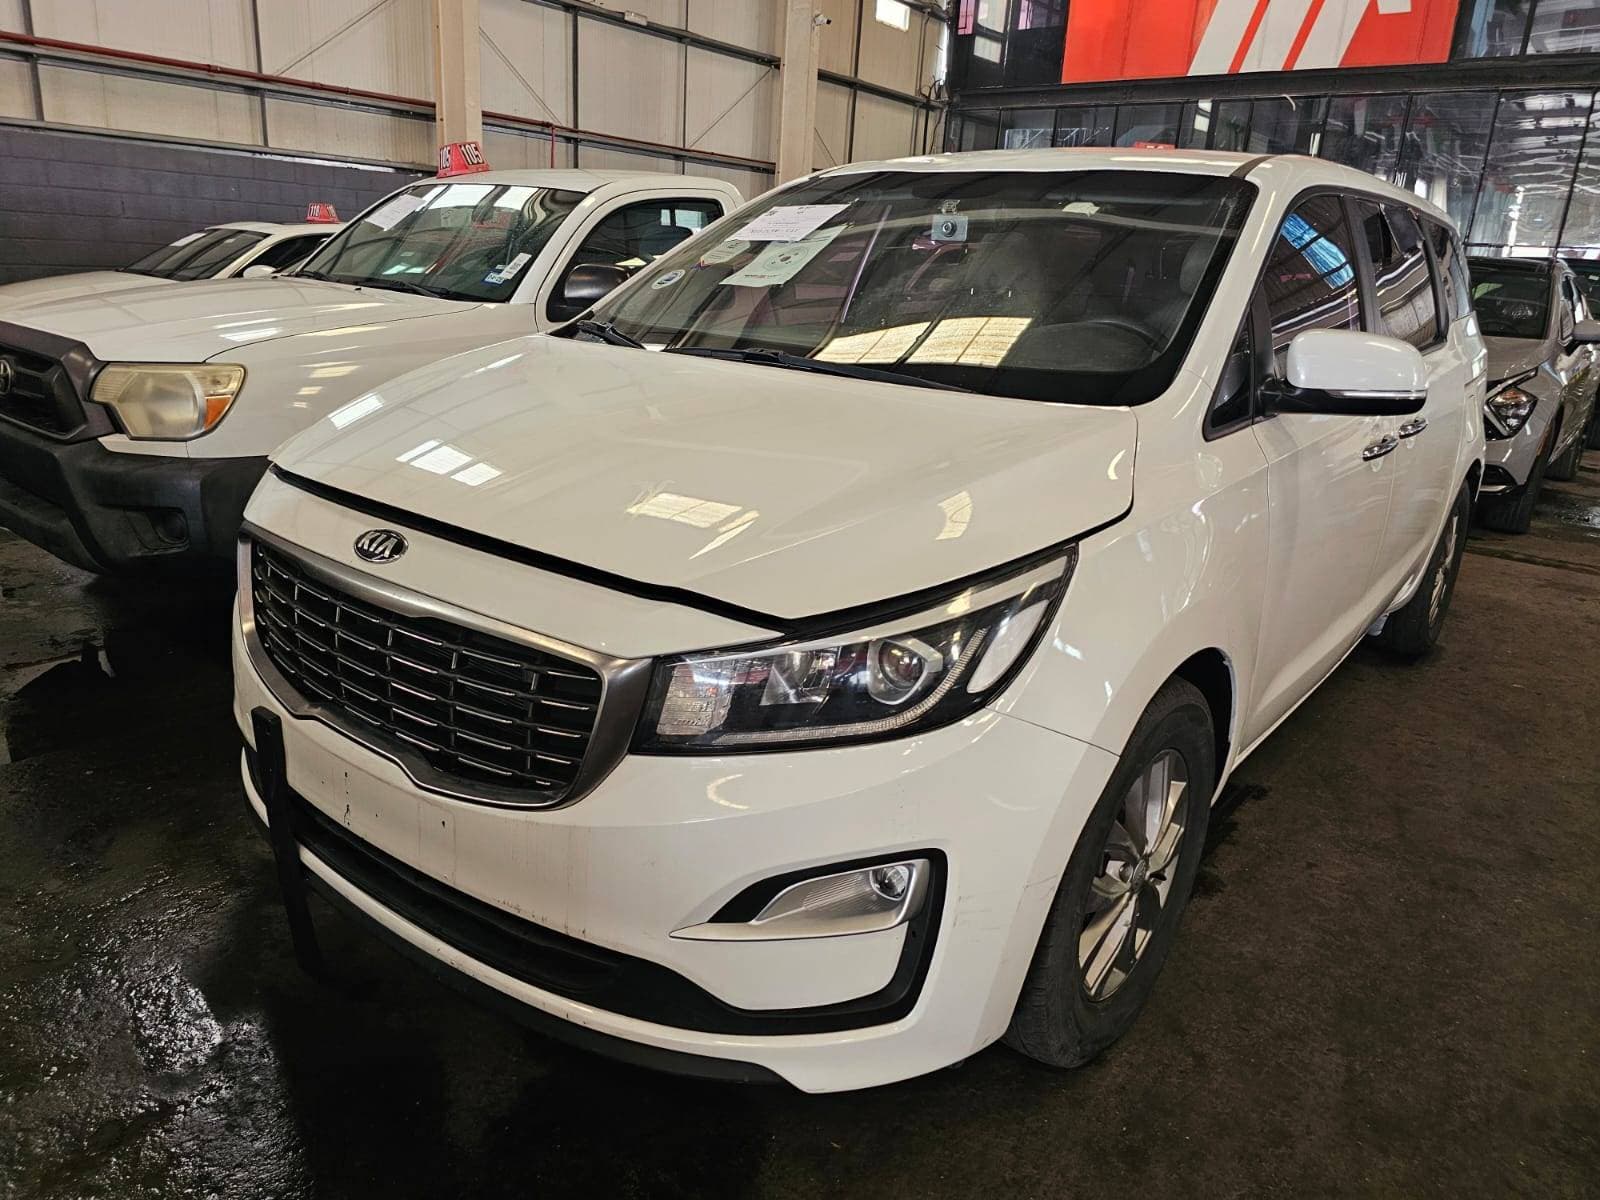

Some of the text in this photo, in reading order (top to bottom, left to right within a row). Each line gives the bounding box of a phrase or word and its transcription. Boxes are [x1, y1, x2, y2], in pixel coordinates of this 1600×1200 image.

[440, 146, 451, 169] 105
[460, 143, 484, 165] 105
[357, 531, 398, 558] KIA
